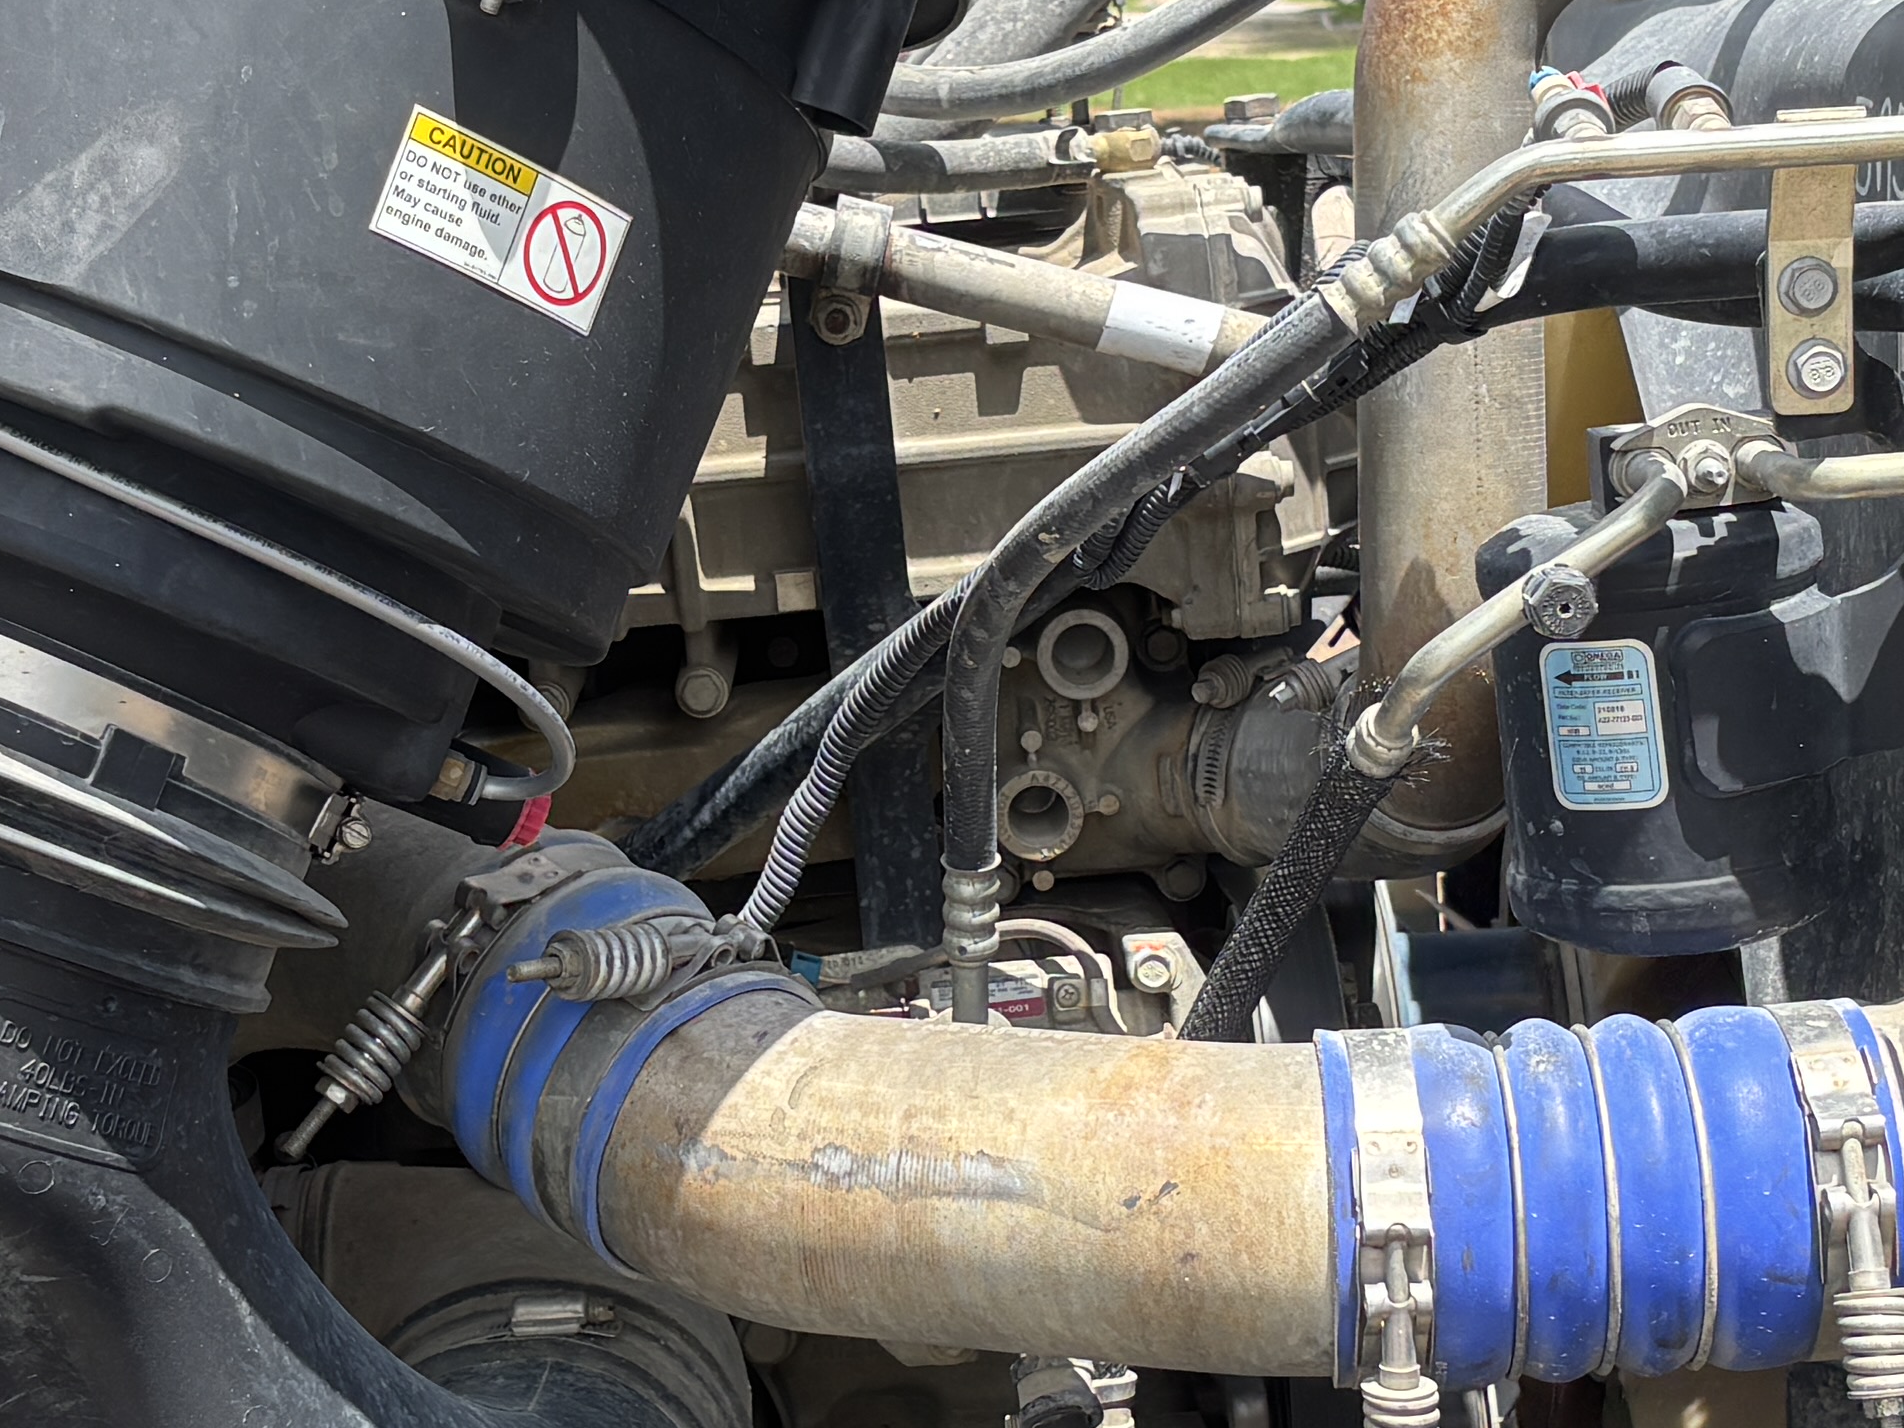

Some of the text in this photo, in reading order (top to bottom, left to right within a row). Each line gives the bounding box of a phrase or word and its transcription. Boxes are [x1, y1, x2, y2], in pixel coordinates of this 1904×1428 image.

[406, 150, 522, 215] DO NOT use ether
[428, 126, 522, 185] CAUTION
[393, 185, 463, 227] May cause
[399, 171, 501, 227] or starting fluid.
[386, 205, 488, 261] engine damage.
[1668, 417, 1731, 438] OUT IN
[90, 1104, 159, 1147] TORQUE
